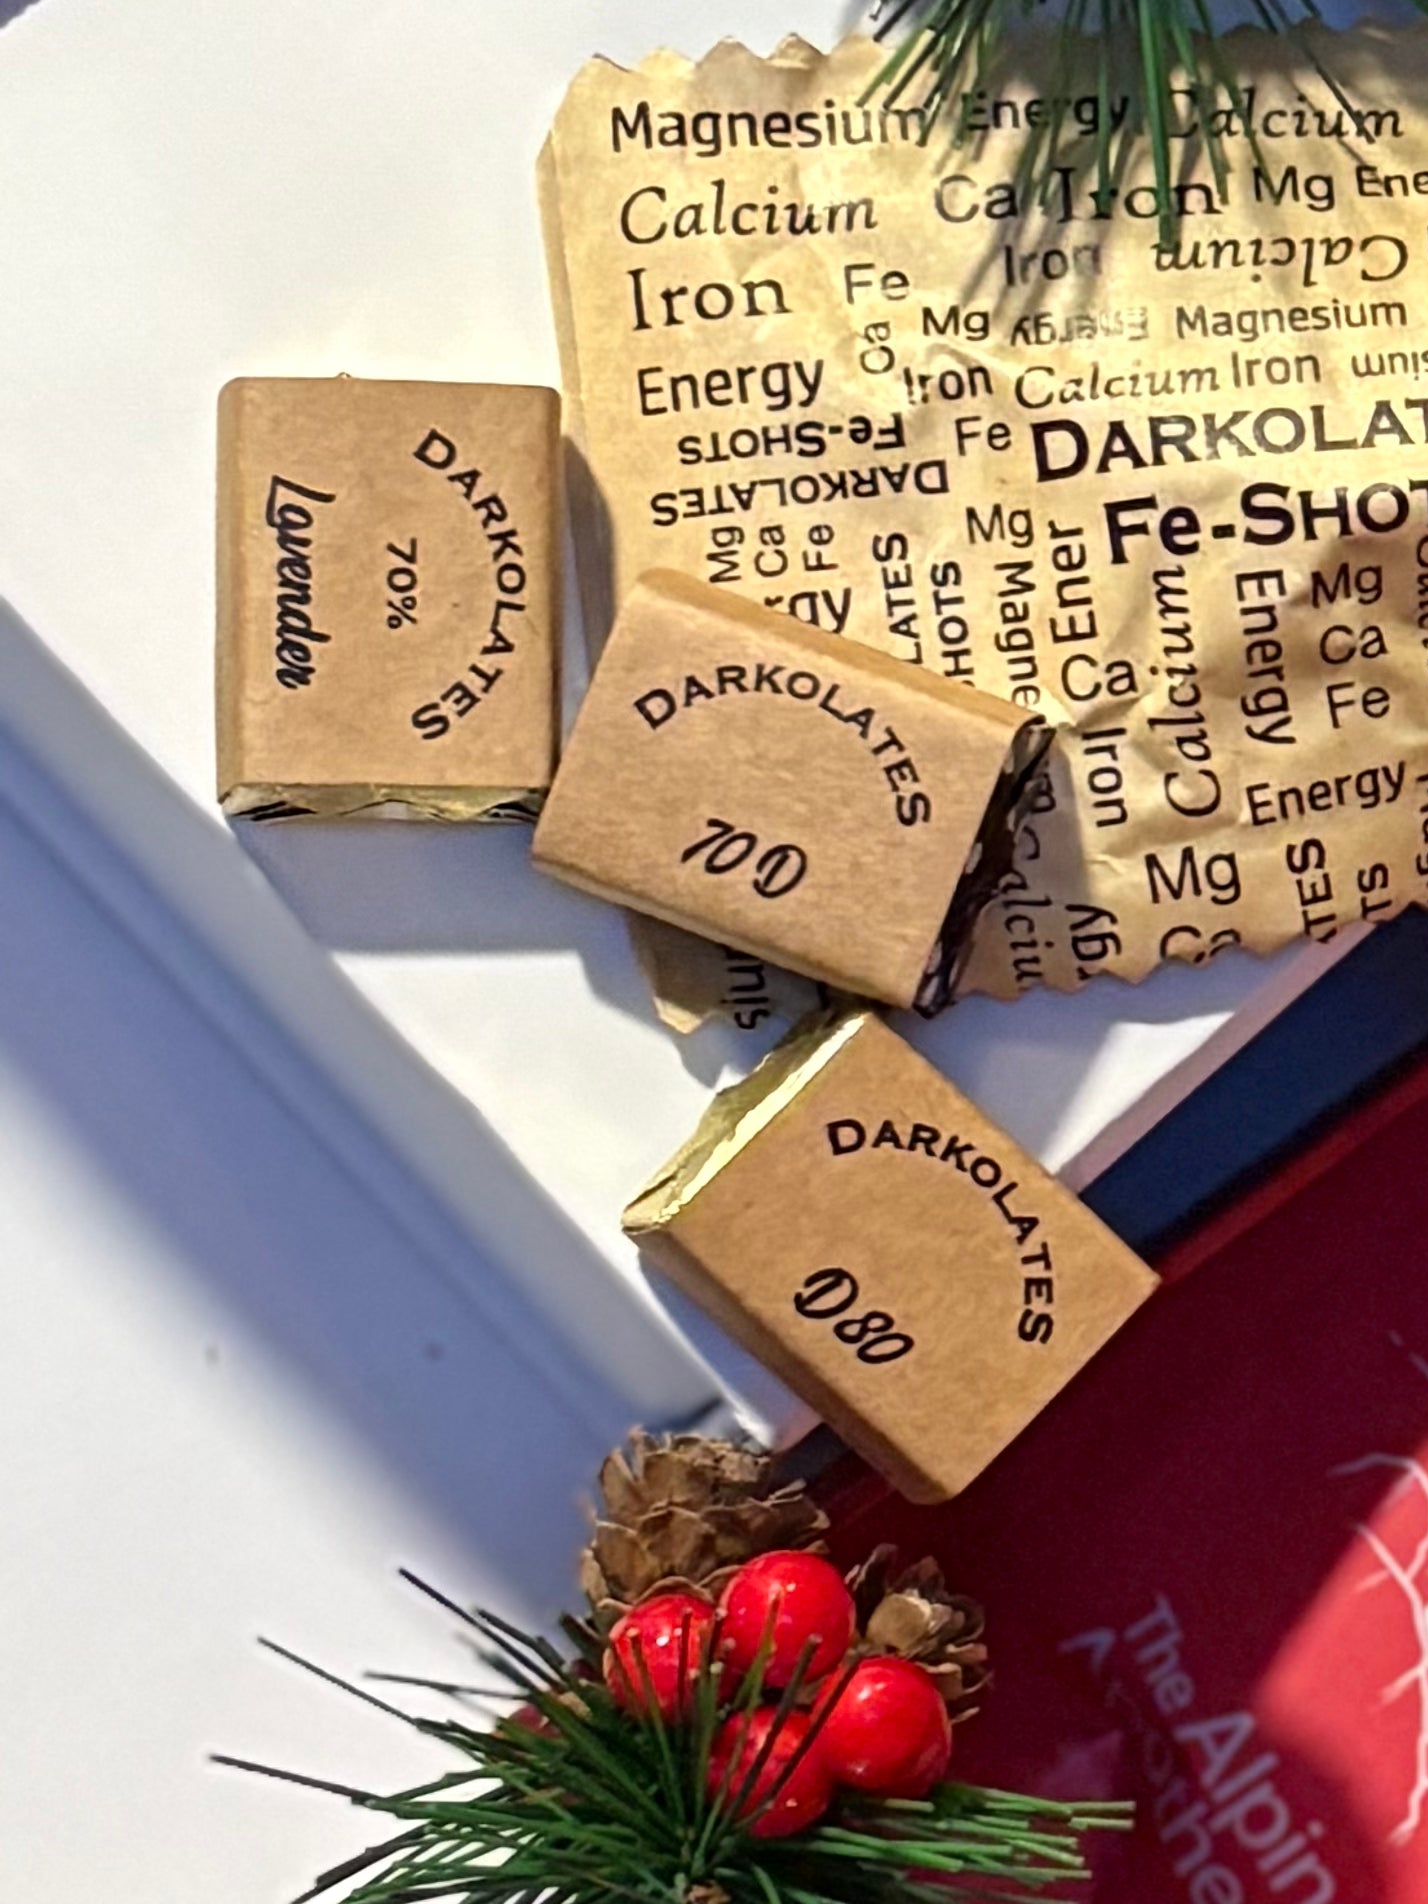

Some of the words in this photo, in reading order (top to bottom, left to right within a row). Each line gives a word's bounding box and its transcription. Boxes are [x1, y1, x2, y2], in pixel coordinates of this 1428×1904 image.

[611, 99, 929, 157] Magnesium
[620, 178, 878, 244] Calcium
[934, 173, 1018, 223] Ca
[1054, 167, 1223, 223] Iron
[1252, 165, 1336, 212] Mg
[844, 263, 910, 305] Fe
[1150, 234, 1408, 287] Calcium
[627, 267, 794, 332] Iron
[922, 305, 990, 342] Mg
[1176, 298, 1407, 343] Magnesium
[860, 321, 895, 375] Ca
[1231, 350, 1321, 388] Iron
[637, 358, 825, 417] Energy
[903, 364, 993, 404] Iron
[1014, 360, 1220, 409] Calcium
[677, 410, 907, 466] Fe-SHOTS
[955, 415, 1012, 457] Fe
[650, 458, 950, 527] DARKOLATES
[754, 524, 789, 578] Ca
[803, 523, 839, 572] Fe
[965, 503, 1035, 548] Mg
[266, 475, 336, 690] Lavender
[706, 526, 745, 583] Mg
[386, 538, 418, 630] 70%
[412, 428, 526, 740] DARKOLATES
[872, 532, 923, 665] LATES
[1311, 563, 1383, 608] Mg
[994, 560, 1041, 710] Magne
[1235, 569, 1297, 744] Energy
[1320, 624, 1388, 664] Ca
[1060, 653, 1138, 701] Ca
[1148, 564, 1221, 816] Calcium
[1326, 681, 1390, 728] Fe
[634, 663, 931, 827] DARKOLATES
[1081, 727, 1128, 828] Iron
[1246, 760, 1405, 826] Energy
[1145, 847, 1241, 905] Mg
[827, 1118, 1054, 1345] DARKOLATES
[1124, 1593, 1195, 1715] The
